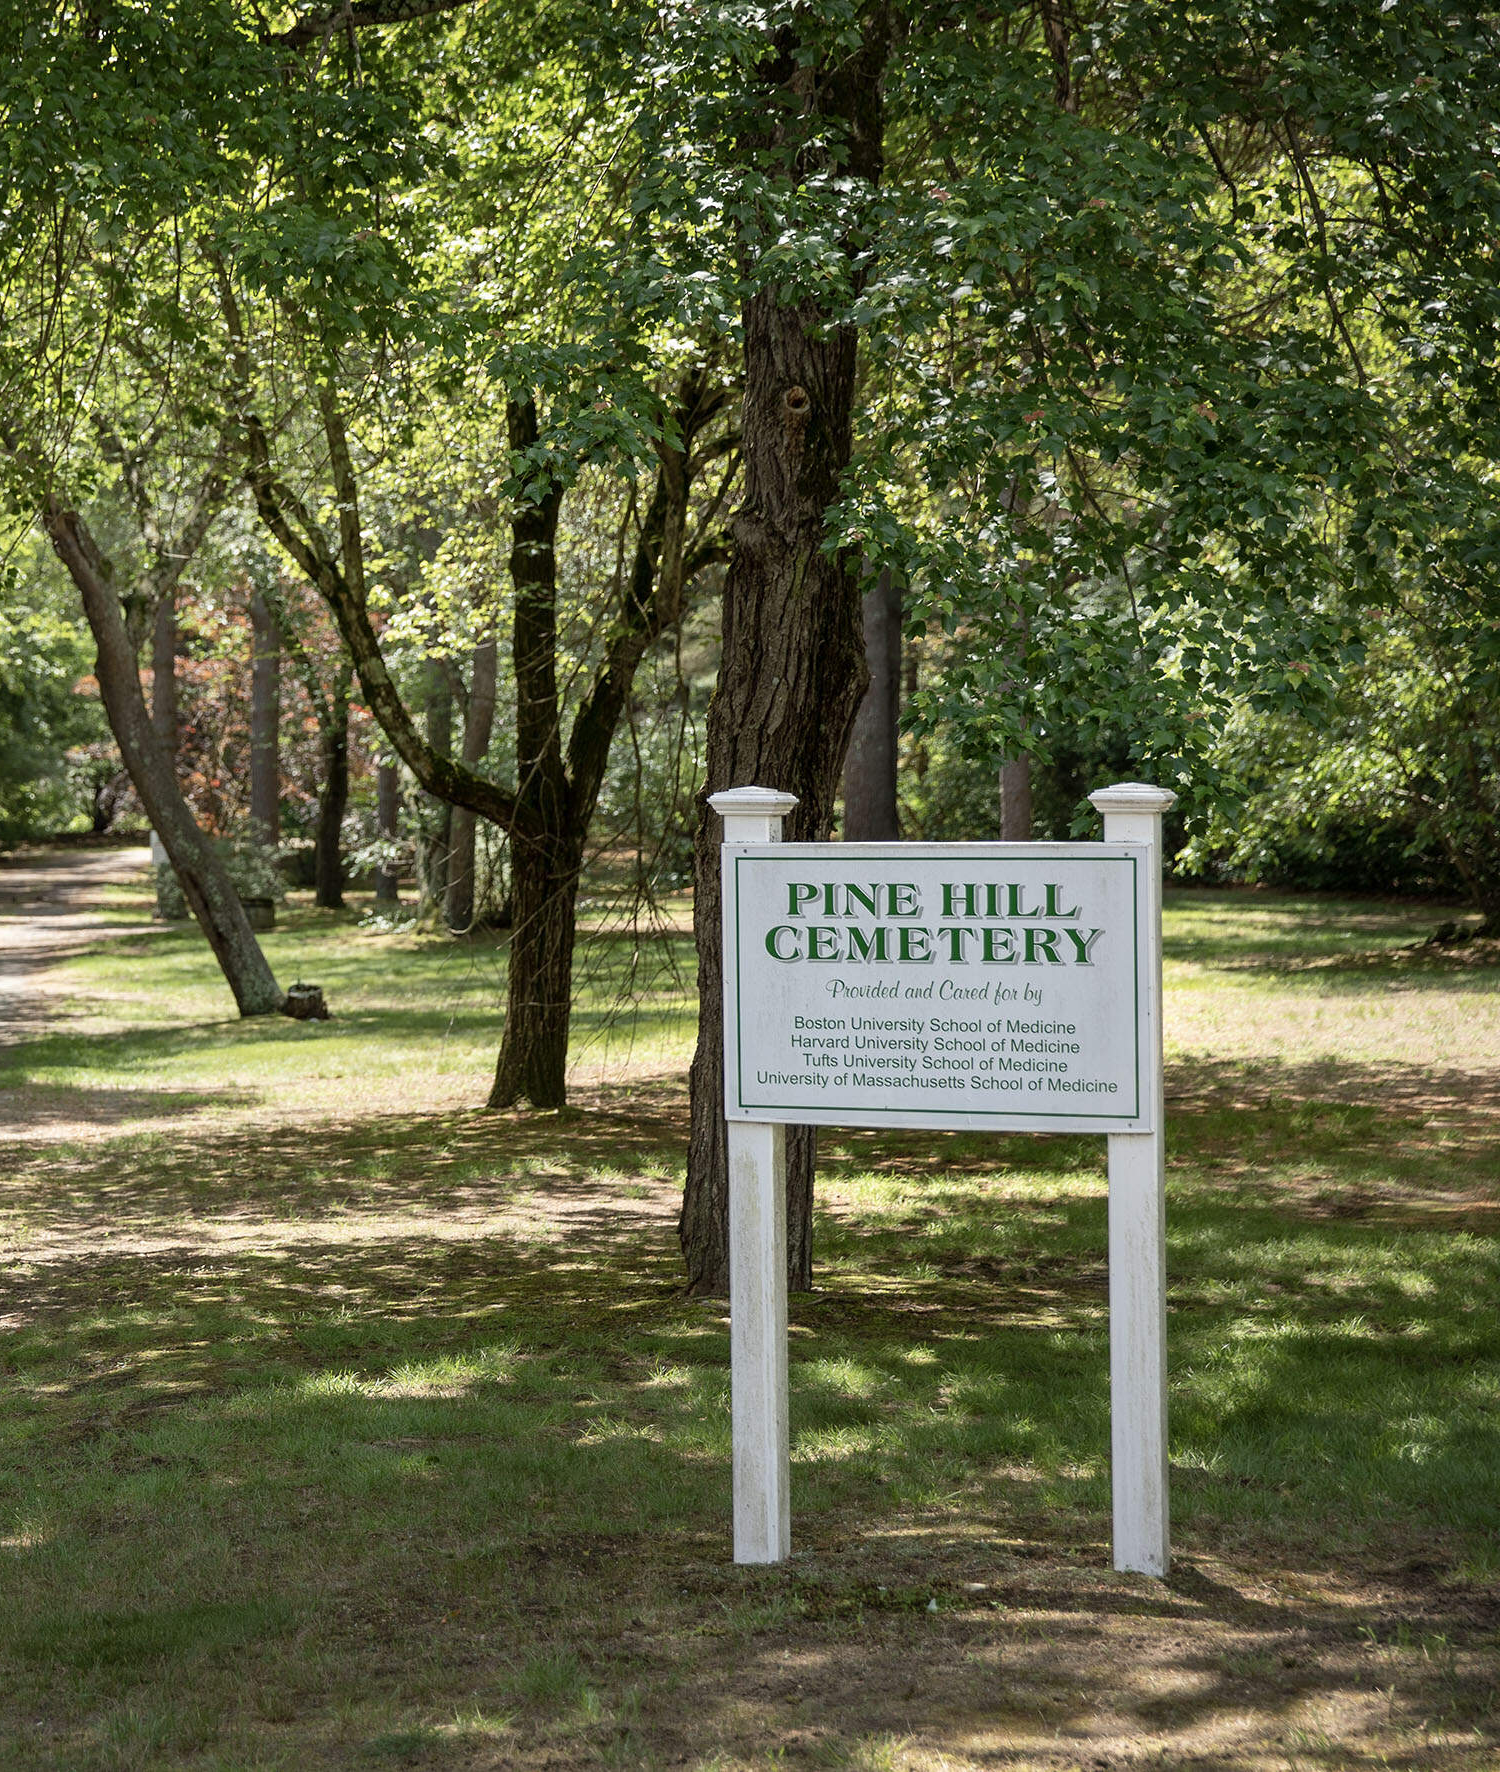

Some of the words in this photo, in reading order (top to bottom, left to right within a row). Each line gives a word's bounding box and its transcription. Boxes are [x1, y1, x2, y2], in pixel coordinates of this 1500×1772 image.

[786, 883, 924, 920] PINE
[940, 883, 1082, 920] HILL
[765, 925, 1106, 967] CEMETERY
[825, 978, 901, 999] Provided
[904, 980, 935, 1000] and
[938, 978, 991, 1001] Cared
[993, 981, 1018, 1007] for
[1023, 982, 1043, 1007] by
[794, 1015, 846, 1031] Boston
[850, 1016, 926, 1036] University
[929, 1017, 982, 1033] School
[986, 1019, 1003, 1033] of
[1006, 1019, 1077, 1035] Medicine
[790, 1033, 850, 1049] Harvard
[854, 1035, 929, 1054] University
[933, 1036, 986, 1052] School
[990, 1038, 1007, 1053] of
[1010, 1038, 1081, 1055] Medicine
[801, 1052, 839, 1068] Tufts
[843, 1053, 918, 1073] University
[921, 1055, 974, 1071] School
[978, 1056, 995, 1072] of
[998, 1057, 1069, 1073] Medicine
[756, 1070, 830, 1089] University
[833, 1072, 849, 1087] of
[852, 1072, 966, 1090] Massachusetts
[970, 1075, 1023, 1091] School
[1027, 1076, 1044, 1092] of
[1047, 1077, 1118, 1094] Medicine
